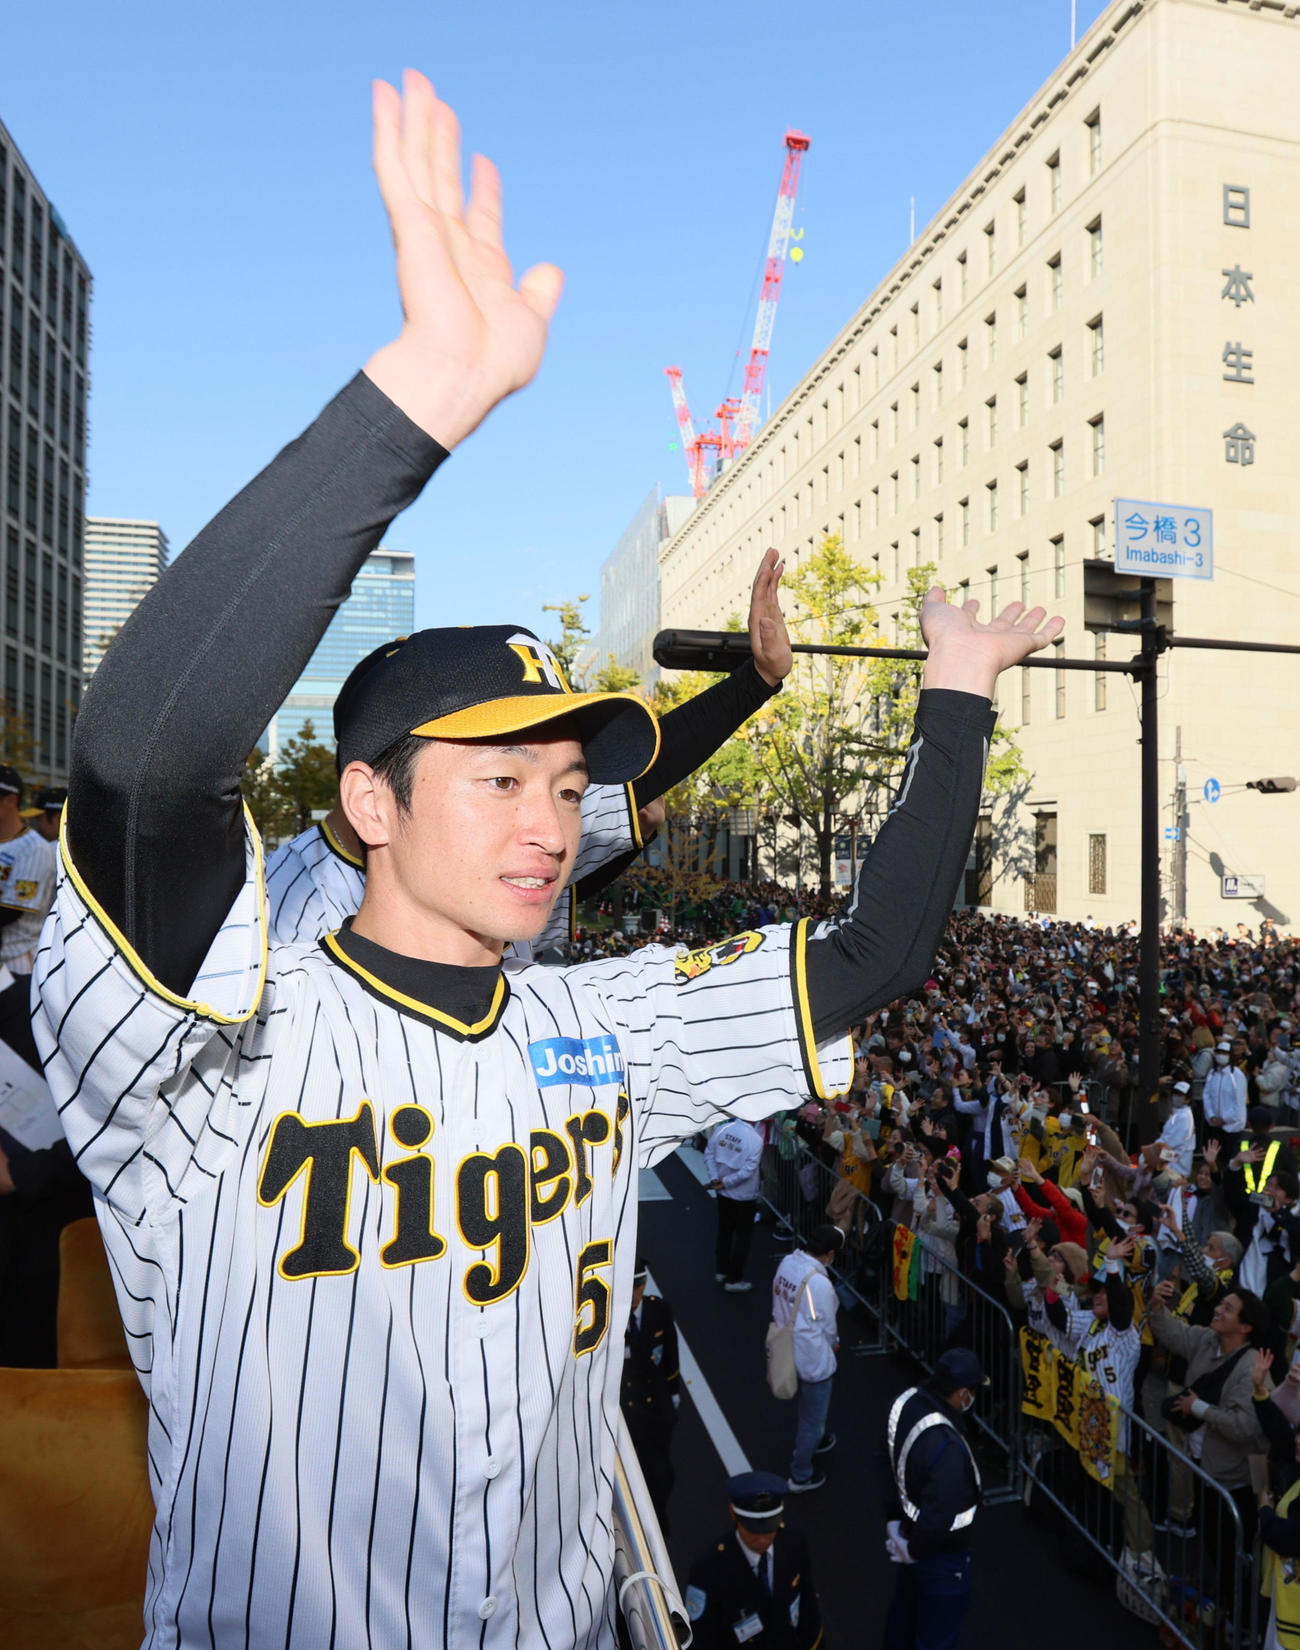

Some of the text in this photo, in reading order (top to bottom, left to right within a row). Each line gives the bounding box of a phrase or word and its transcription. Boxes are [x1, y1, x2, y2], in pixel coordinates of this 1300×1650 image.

[1222, 184, 1256, 466] 日本生命
[1126, 545, 1203, 568] Imabashi-3
[725, 1134, 742, 1145] STAFF
[779, 1276, 797, 1293] STAFF
[573, 1238, 613, 1359] 5
[1104, 1367, 1117, 1383] 5
